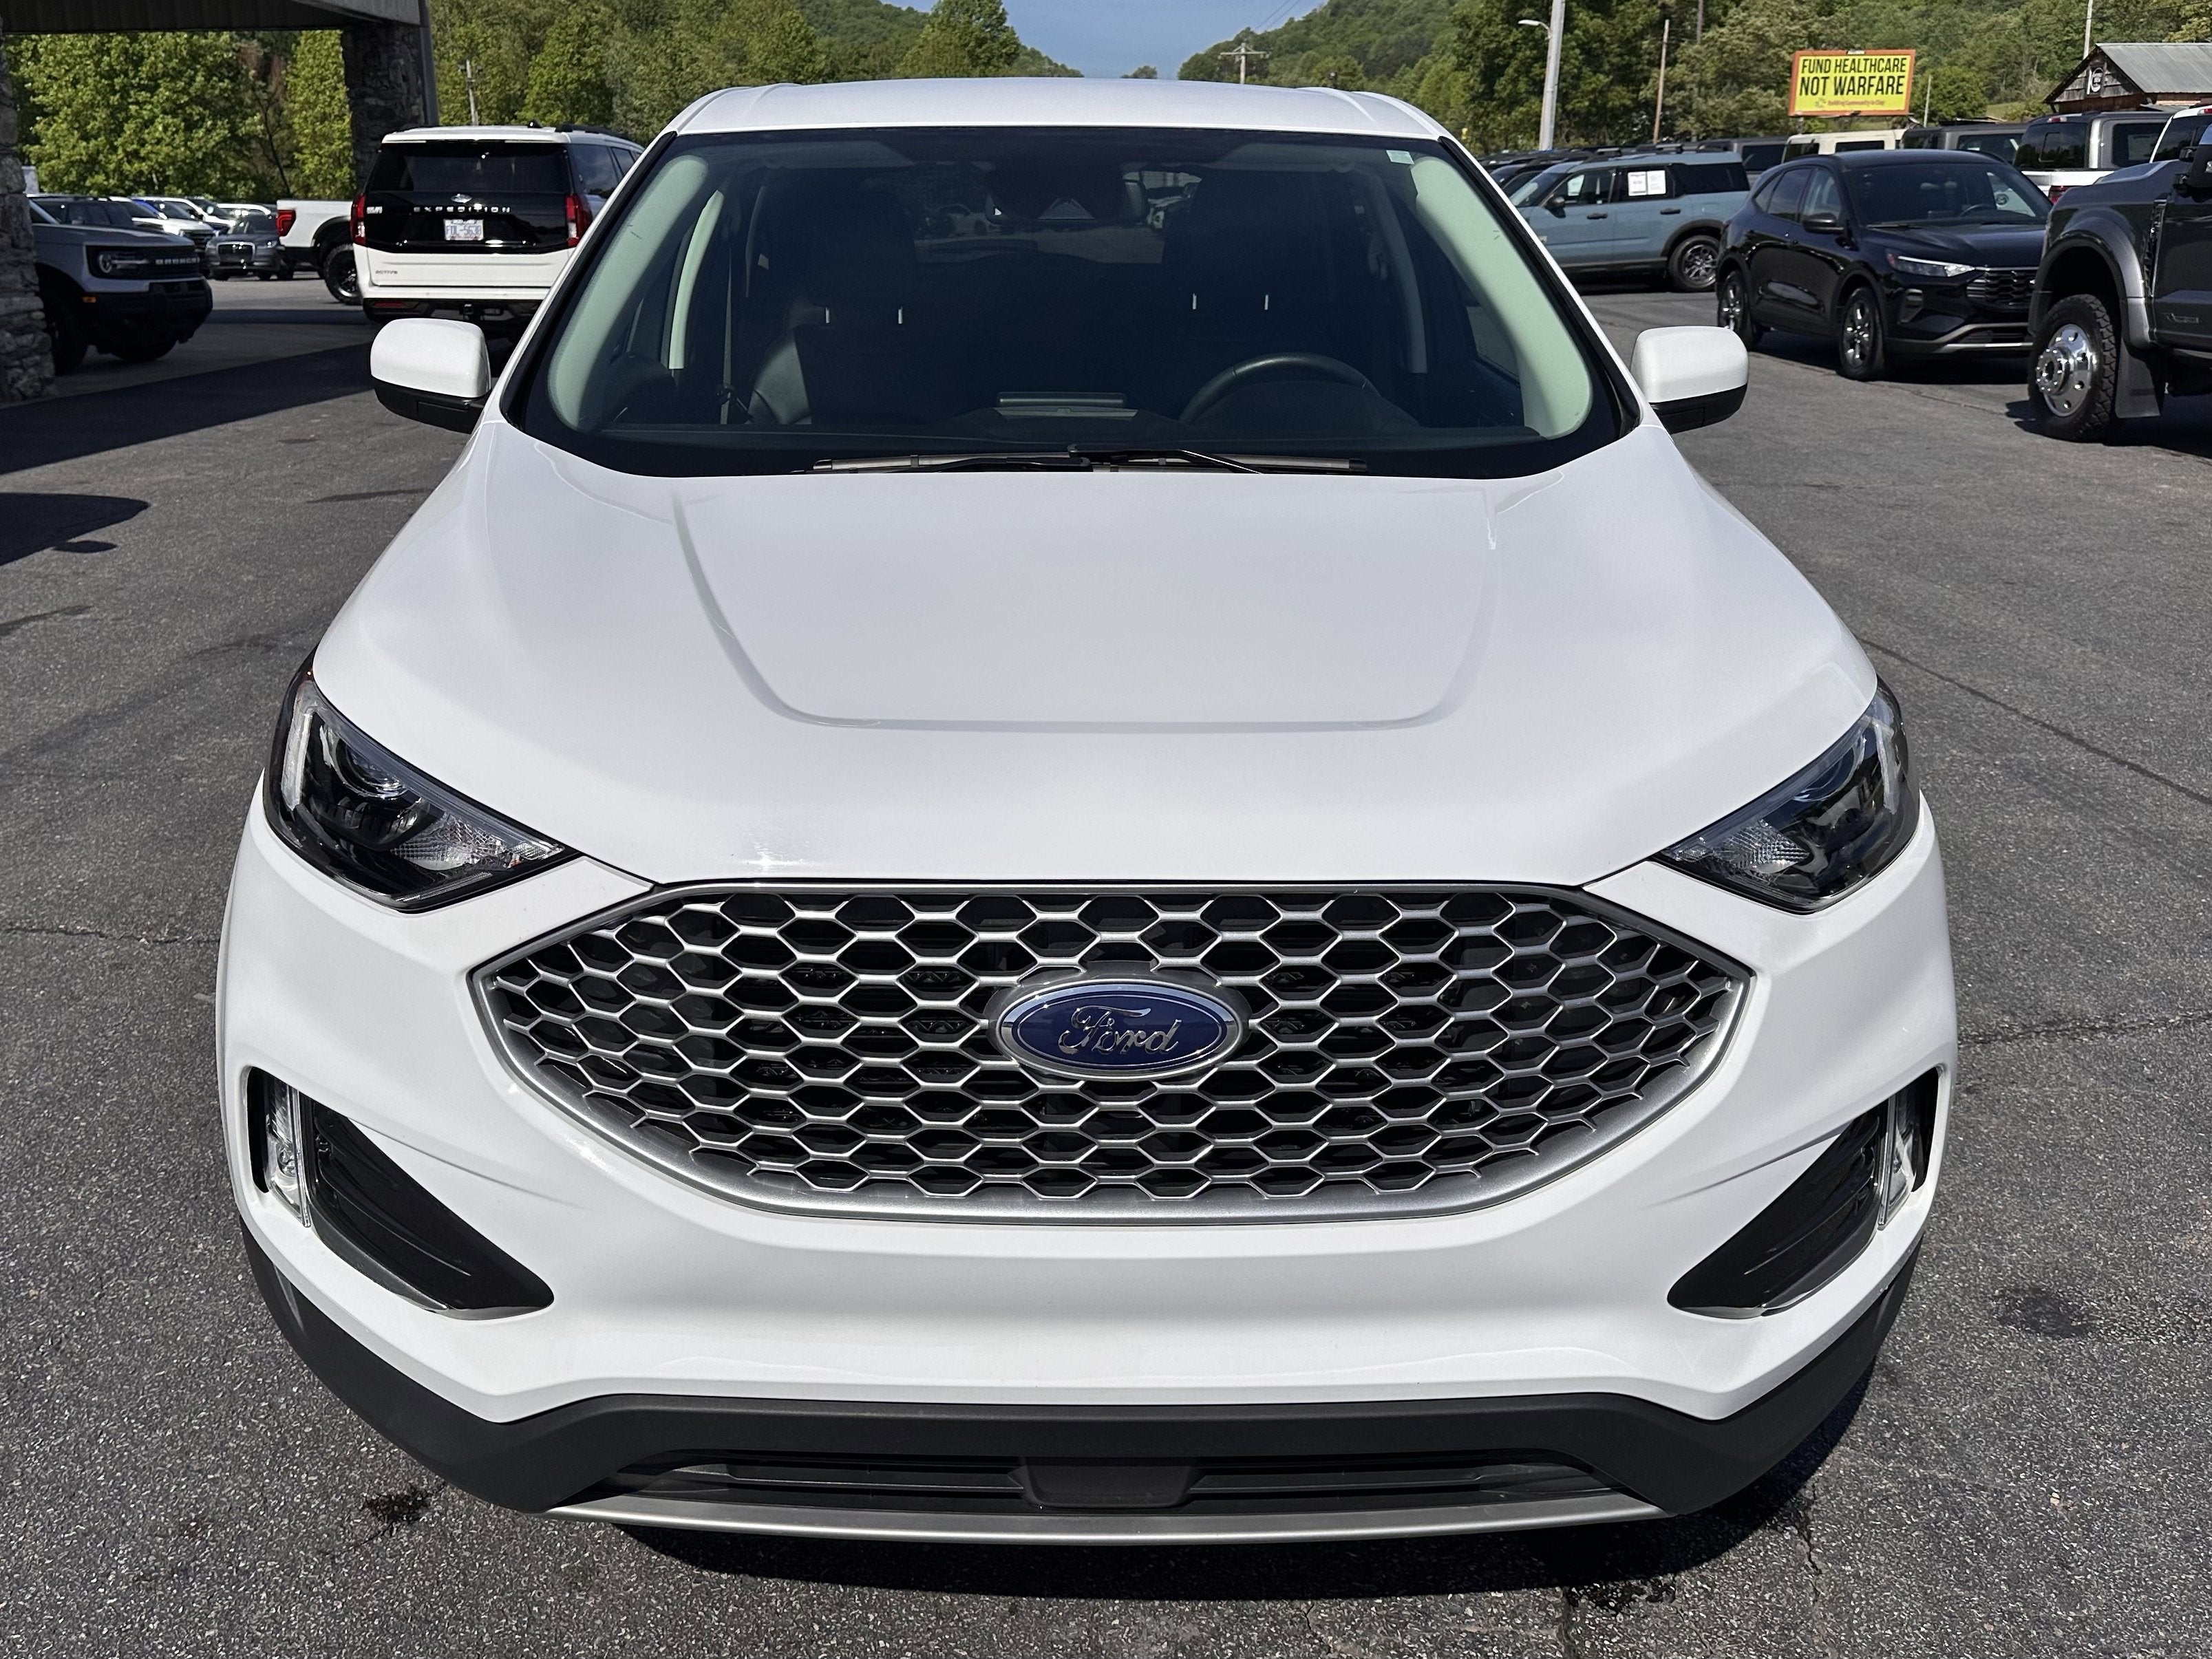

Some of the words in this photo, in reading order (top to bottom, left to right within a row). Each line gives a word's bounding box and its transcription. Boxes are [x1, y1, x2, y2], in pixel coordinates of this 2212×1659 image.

[1801, 58, 1831, 74] FUND
[1834, 58, 1907, 73] HEALTHCARE
[1799, 76, 1829, 96] NOT
[1833, 76, 1905, 95] WARFARE
[1058, 1005, 1182, 1054] Ford
